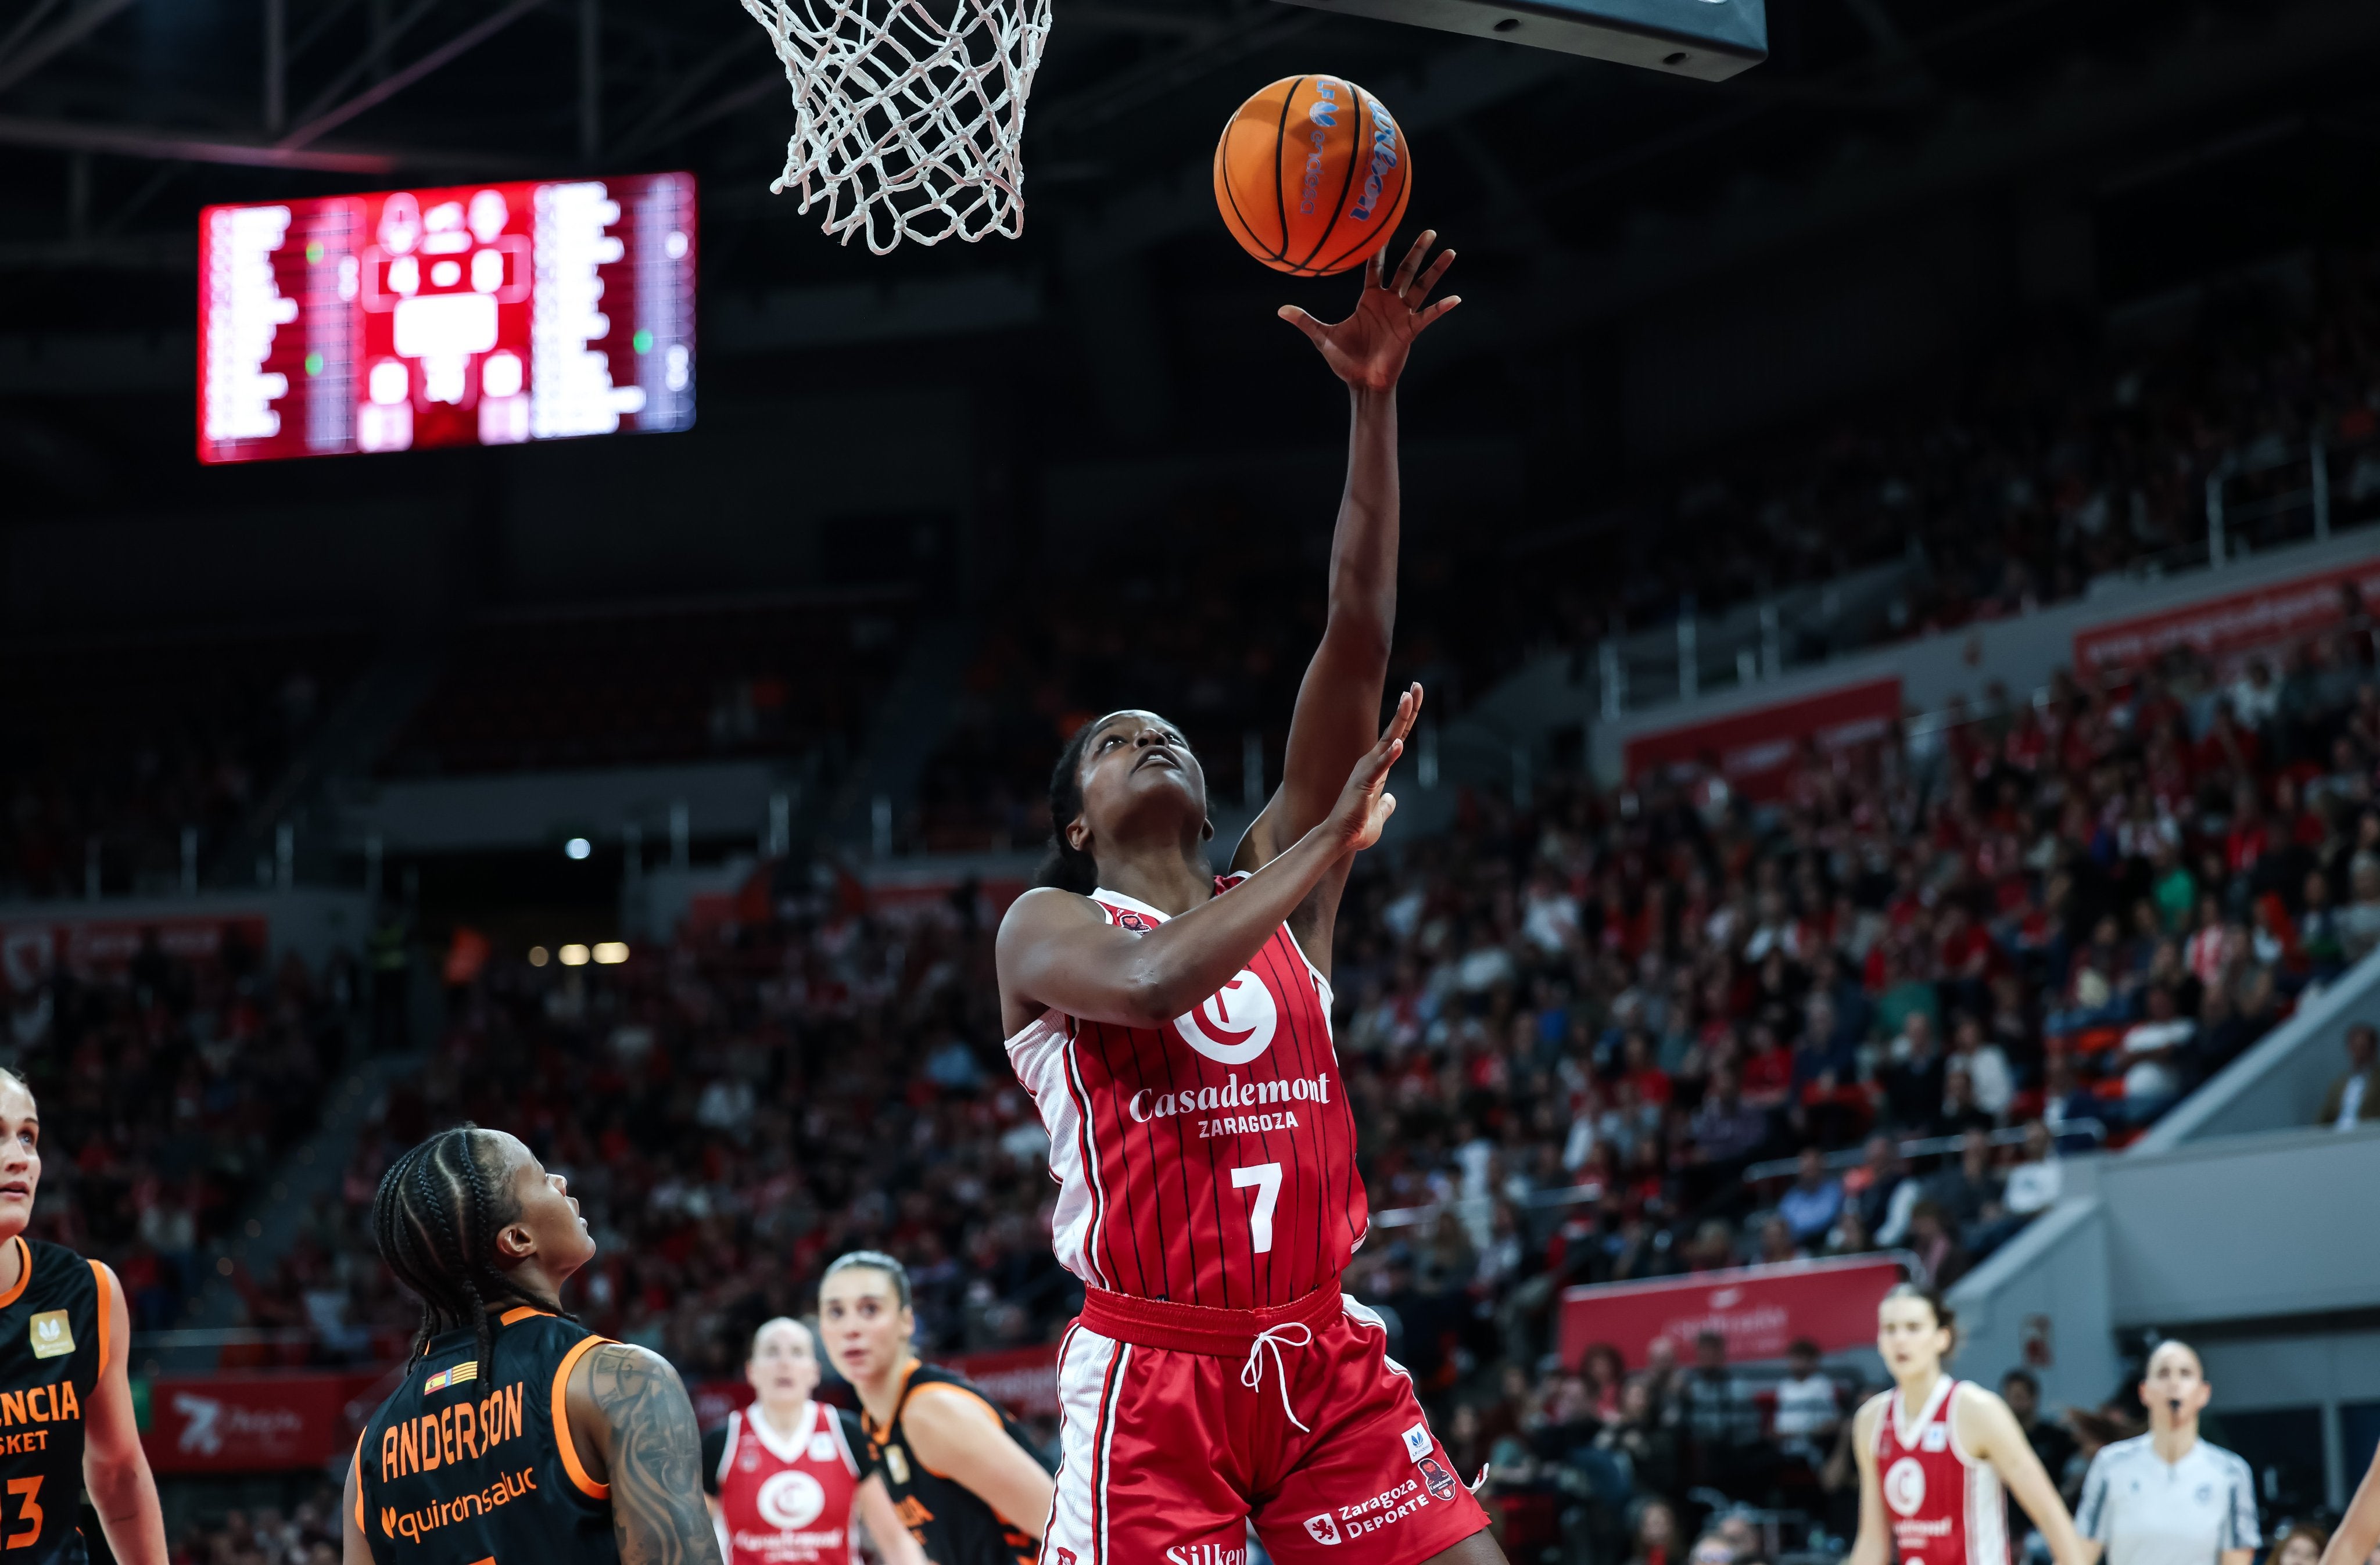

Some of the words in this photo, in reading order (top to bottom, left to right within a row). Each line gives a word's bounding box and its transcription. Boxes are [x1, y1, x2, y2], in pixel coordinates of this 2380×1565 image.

[1317, 80, 1336, 99] LF
[1300, 130, 1325, 214] endesa
[1349, 100, 1397, 221] Wilson
[1129, 1072, 1331, 1124] Casademont
[1198, 1111, 1299, 1139] ZARAGOZA
[1230, 1162, 1283, 1254] 7
[0, 1380, 80, 1426] NCIA
[382, 1381, 523, 1483] ANDERSON
[0, 1474, 45, 1550] 3
[1338, 1479, 1418, 1521] Zaragoza
[1345, 1494, 1429, 1539] DEPORTE
[1166, 1544, 1245, 1565] Silken
